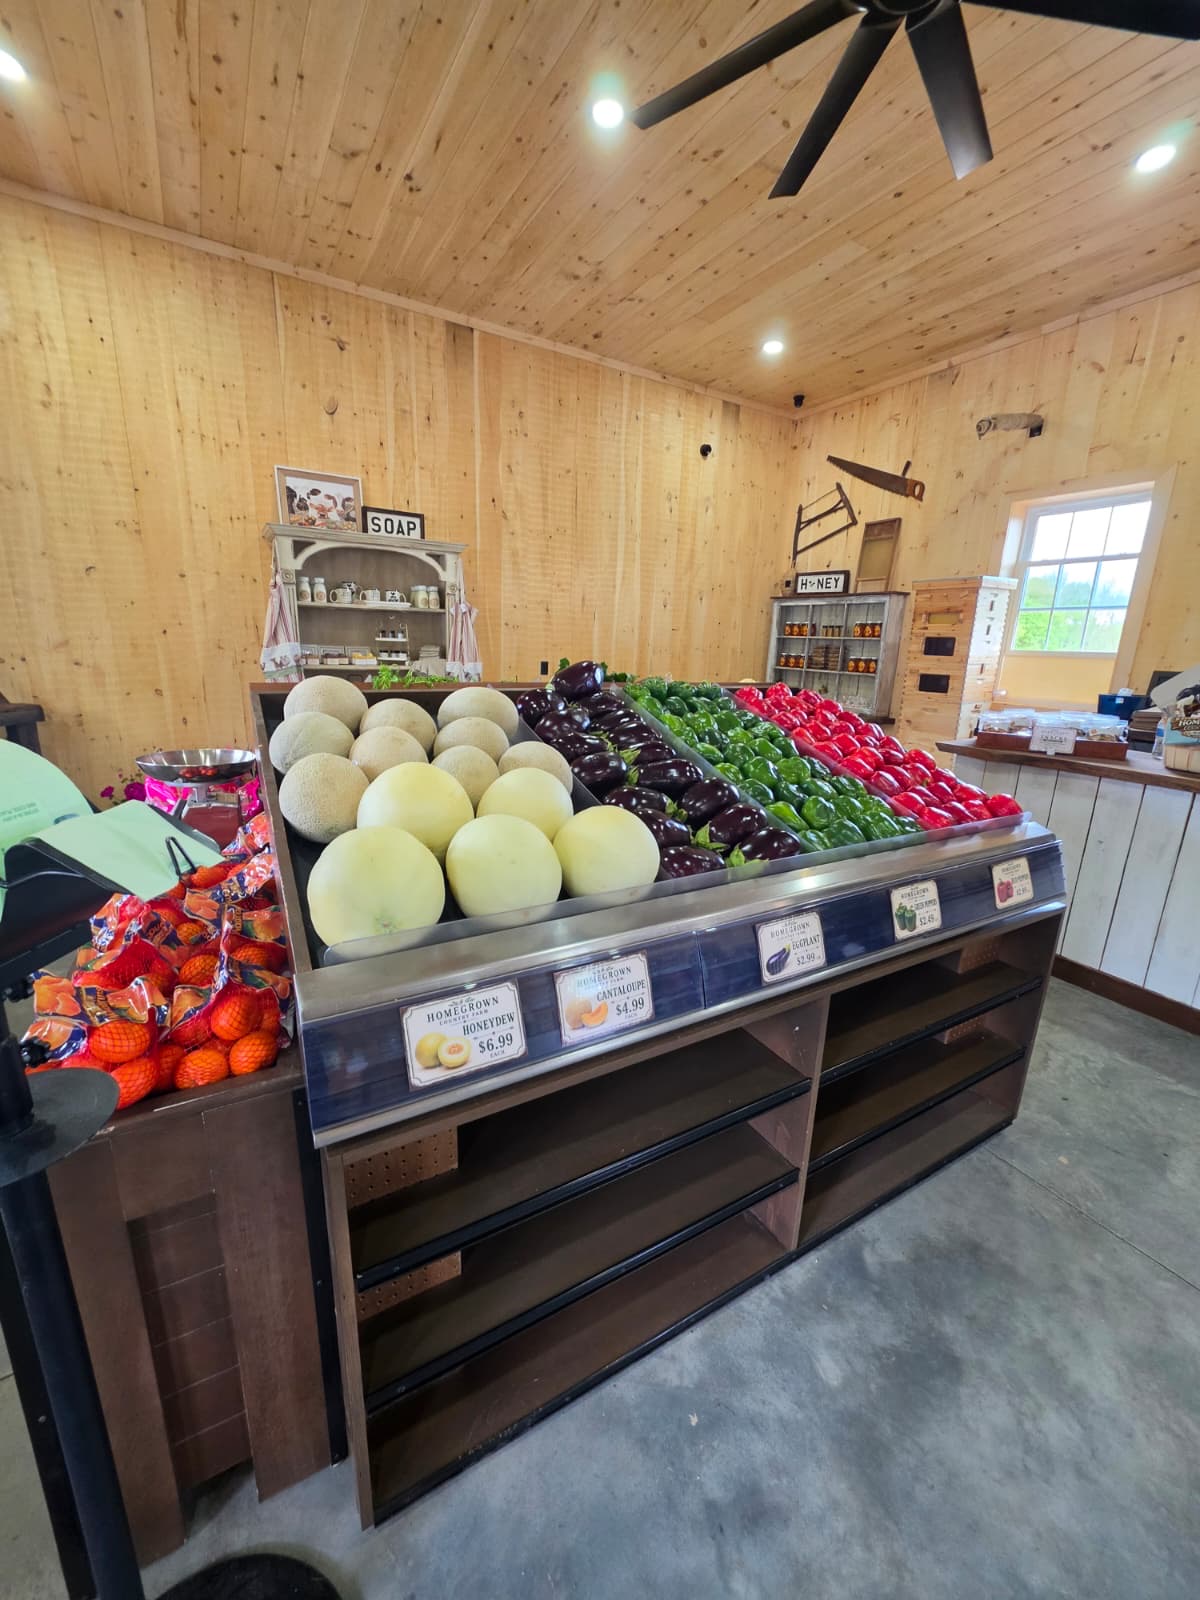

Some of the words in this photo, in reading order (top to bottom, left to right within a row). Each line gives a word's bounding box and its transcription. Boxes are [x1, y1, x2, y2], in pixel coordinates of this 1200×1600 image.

[371, 516, 417, 537] SOAP
[800, 576, 841, 590] HNEY
[771, 921, 810, 938] HOMEGROWN
[792, 934, 820, 950] EGGPLANT
[796, 952, 815, 966] $2.99
[577, 965, 632, 987] HOMEGROWN
[596, 979, 646, 1001] CANTALOUPE
[427, 996, 499, 1023] HOMEGROWN
[615, 997, 645, 1016] $4.99
[462, 1011, 516, 1036] HONEYDEW
[478, 1032, 513, 1054] $6.99
[489, 1049, 505, 1059] EACH
